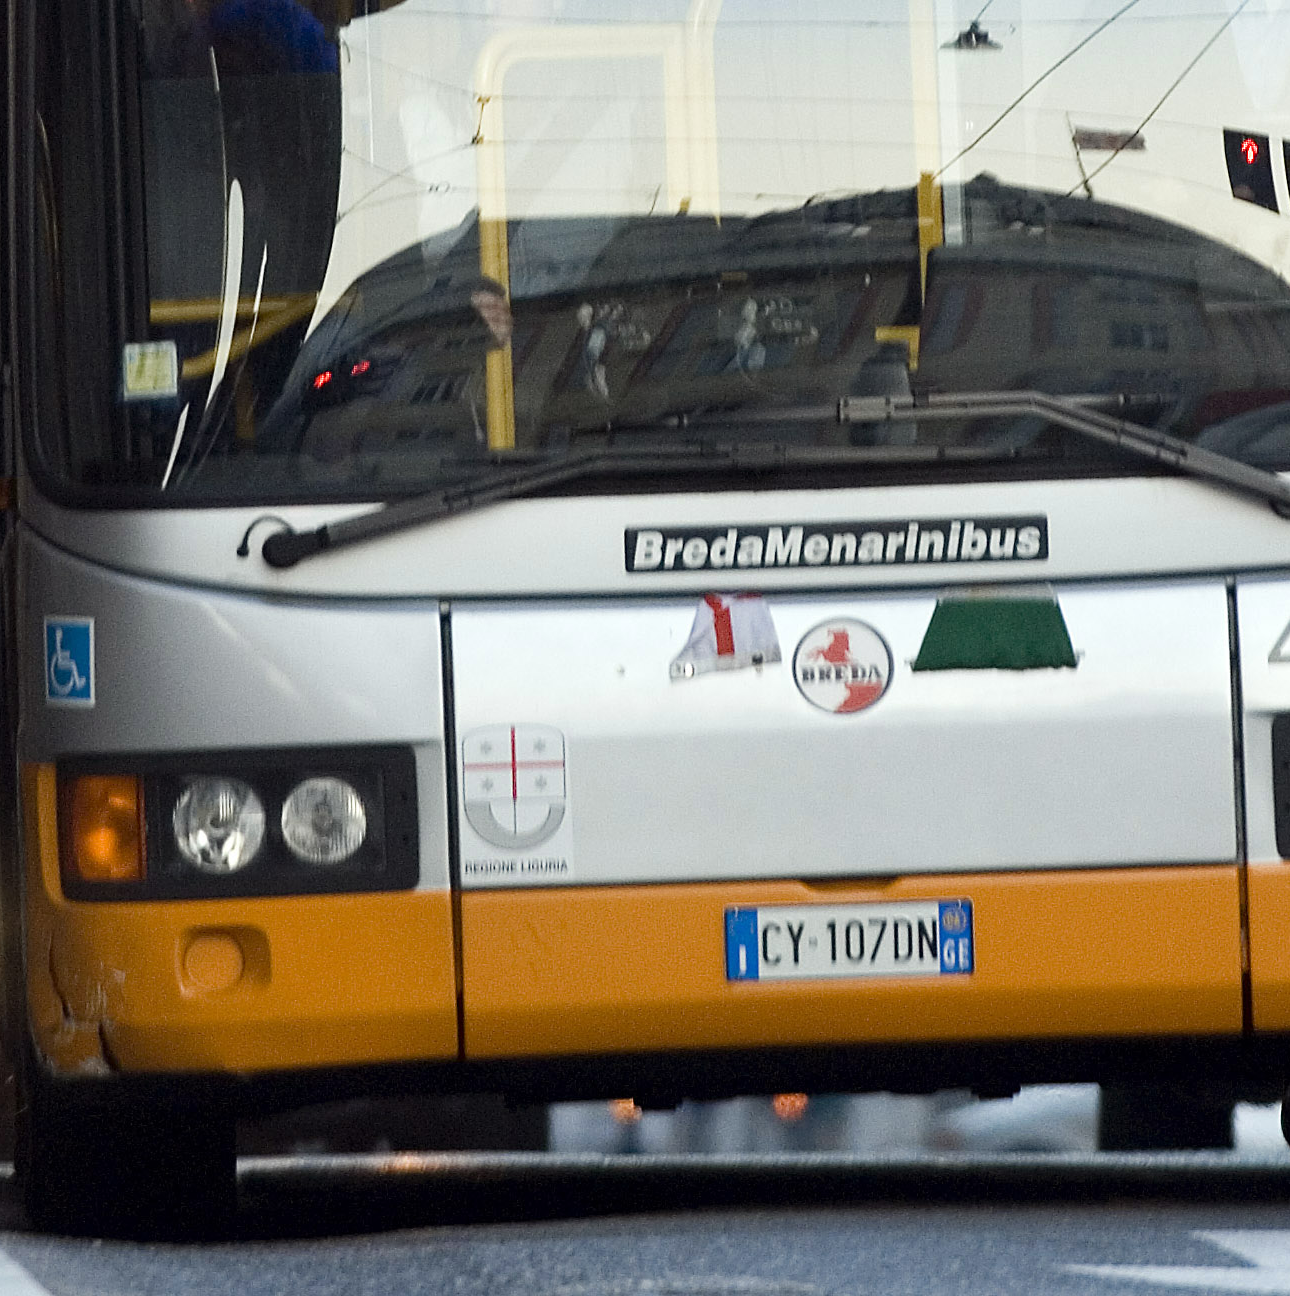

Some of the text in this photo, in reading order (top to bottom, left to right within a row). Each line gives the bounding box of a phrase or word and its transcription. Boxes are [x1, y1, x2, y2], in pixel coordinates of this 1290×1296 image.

[632, 519, 1042, 570] BredaMenarinibus
[802, 664, 882, 681] BREDA
[762, 920, 805, 967] CY
[826, 916, 938, 964] 107DN
[943, 937, 969, 970] GE
